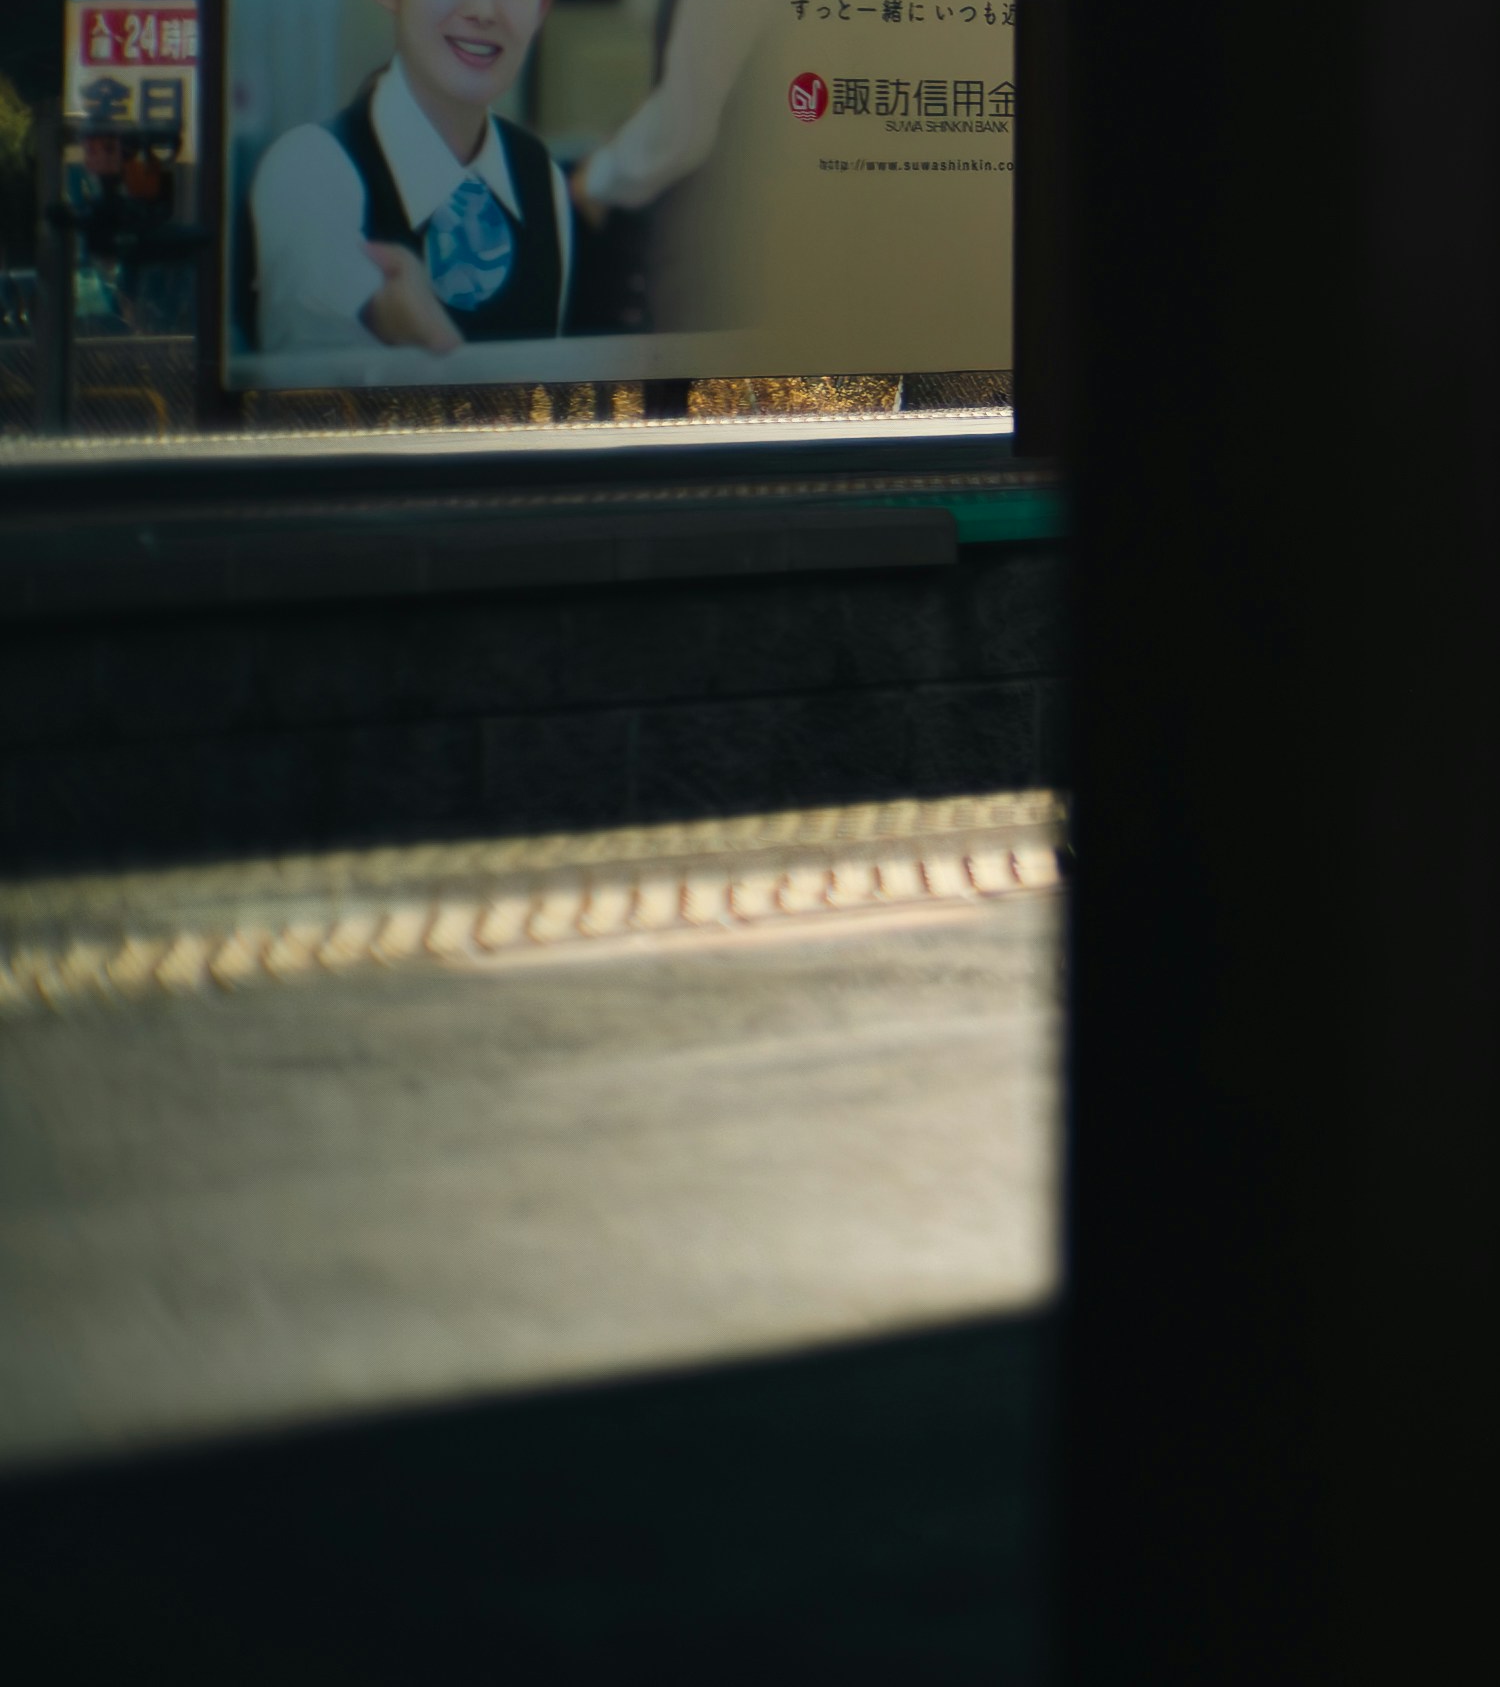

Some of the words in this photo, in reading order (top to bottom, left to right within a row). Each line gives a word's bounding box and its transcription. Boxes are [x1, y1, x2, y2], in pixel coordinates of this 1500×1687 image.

[832, 78, 1016, 117] 諏訪信用金
[885, 120, 924, 133] SUWA
[926, 120, 974, 133] SHINKIN
[975, 120, 1009, 133] BANK
